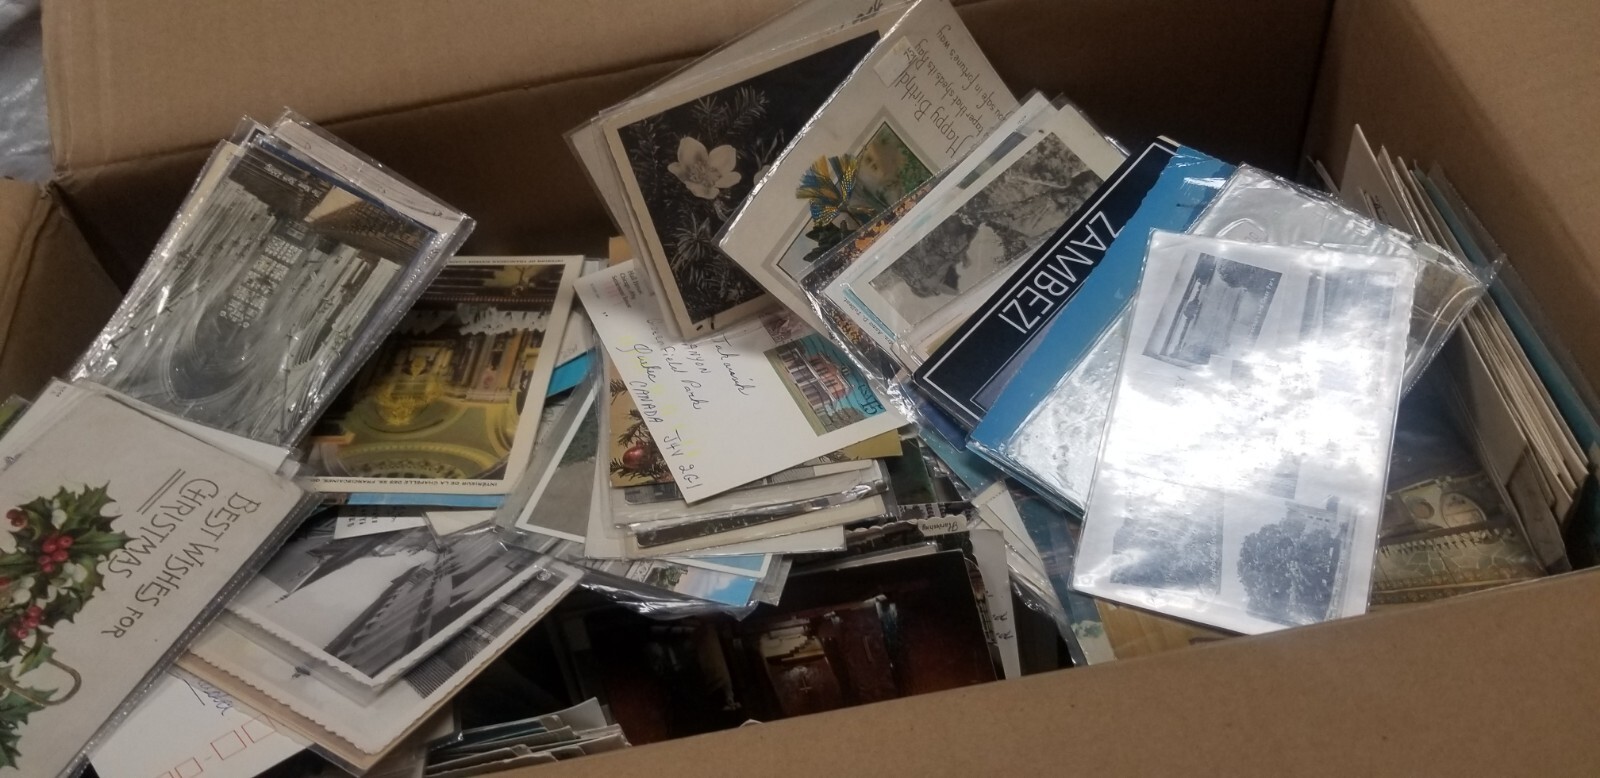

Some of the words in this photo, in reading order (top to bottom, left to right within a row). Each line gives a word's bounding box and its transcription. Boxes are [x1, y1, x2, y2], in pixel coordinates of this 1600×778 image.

[936, 24, 952, 49] way
[934, 72, 954, 100] sheds
[949, 48, 979, 91] fortune's
[893, 71, 933, 122] Birthd
[950, 95, 968, 118] that
[975, 91, 995, 112] safe
[930, 105, 974, 158] Happy
[966, 112, 984, 137] taper
[998, 210, 1125, 335] ZAMBEZI
[681, 342, 712, 374] ANYON
[629, 380, 664, 424] CANADA
[681, 379, 709, 410] Park
[107, 478, 219, 578] CHRISTMAS
[200, 492, 262, 542] BEST
[134, 542, 220, 607] WISHES
[101, 606, 144, 638] FOR
